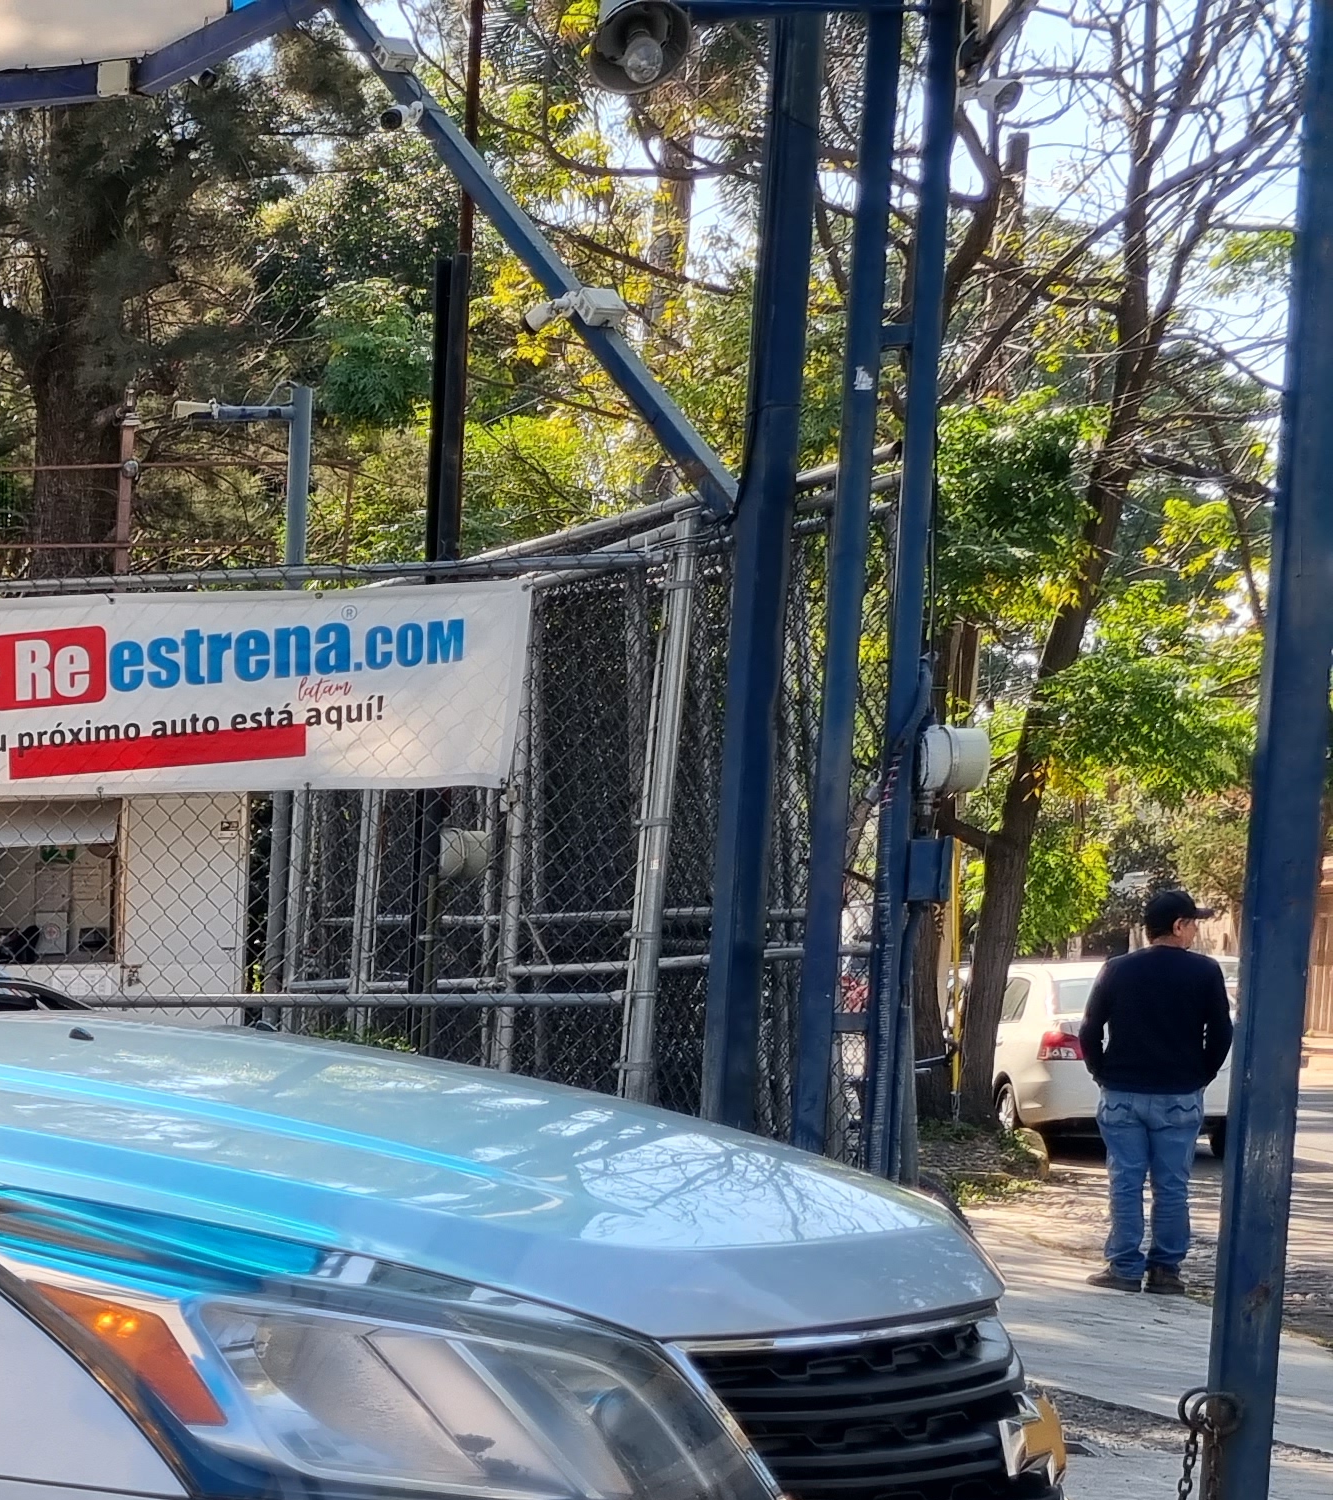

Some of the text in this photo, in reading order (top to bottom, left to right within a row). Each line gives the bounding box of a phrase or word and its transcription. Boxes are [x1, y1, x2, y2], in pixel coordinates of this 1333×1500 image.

[297, 675, 353, 702] latam
[17, 719, 141, 758] próximo
[151, 713, 221, 740] auto
[230, 703, 294, 733] está
[305, 695, 385, 731] aquí!
